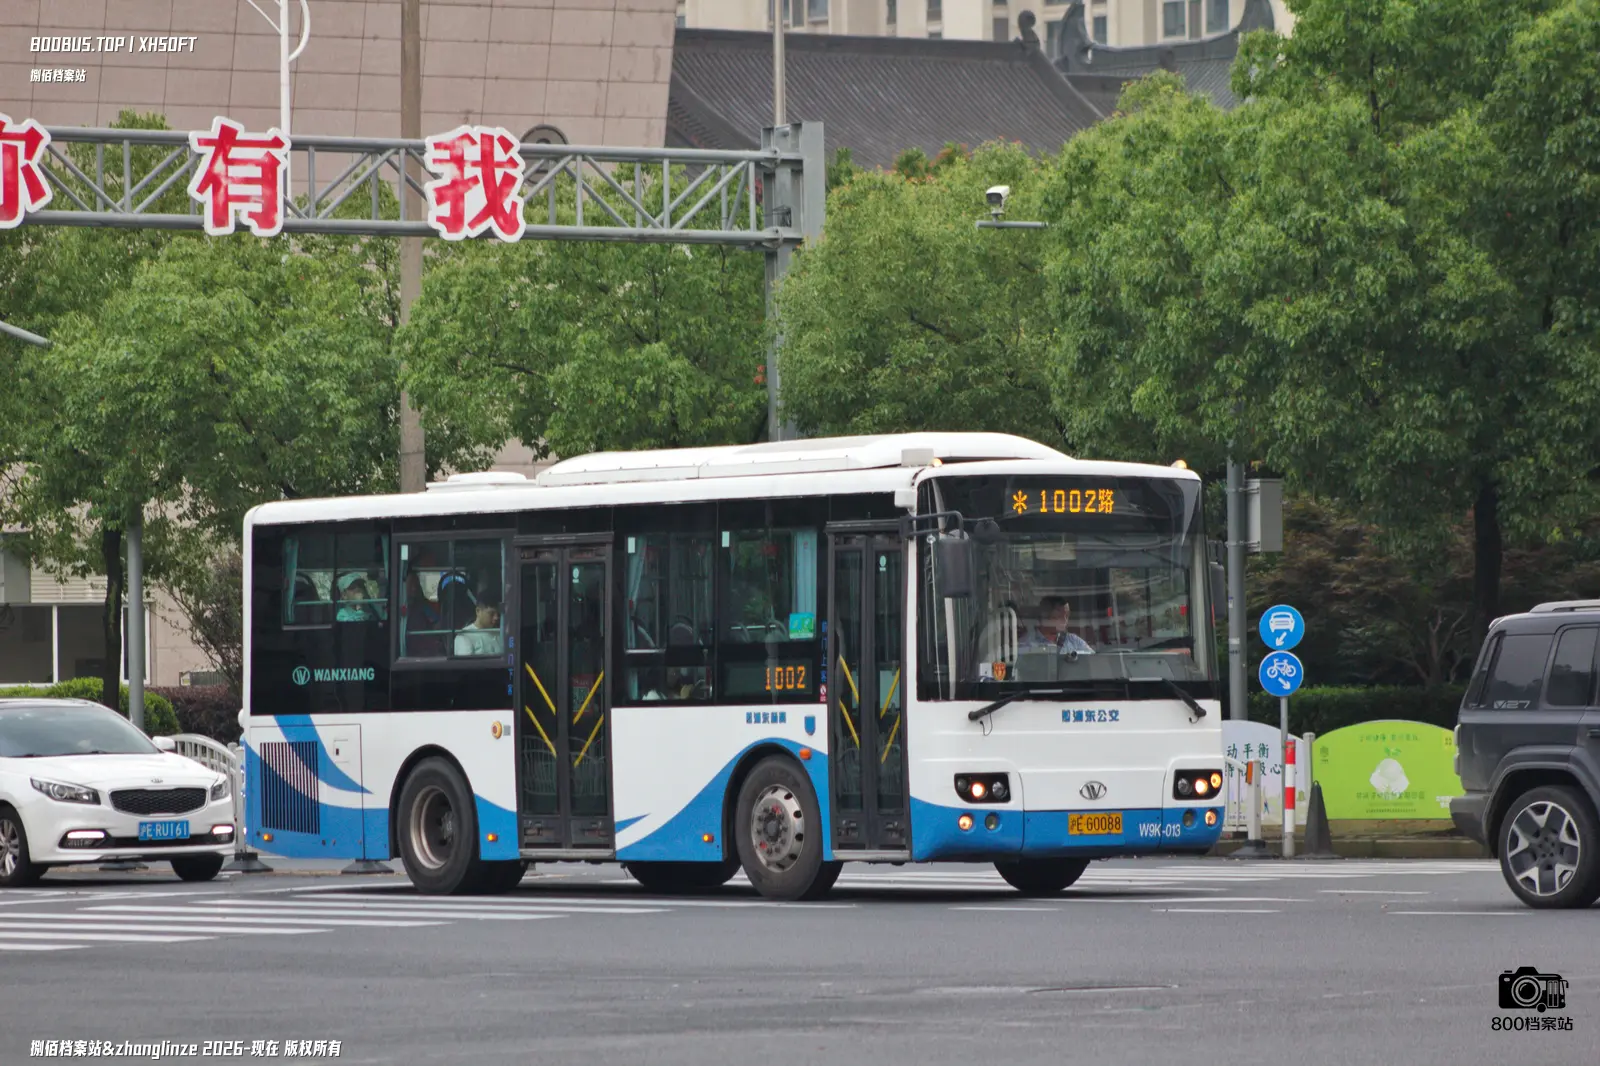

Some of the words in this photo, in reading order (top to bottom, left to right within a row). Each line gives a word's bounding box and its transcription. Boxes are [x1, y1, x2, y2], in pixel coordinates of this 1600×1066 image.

[1039, 488, 1115, 514] 1002路
[314, 667, 375, 681] WANXIANG
[765, 665, 806, 690] 1002
[1139, 823, 1181, 838] W9K-013
